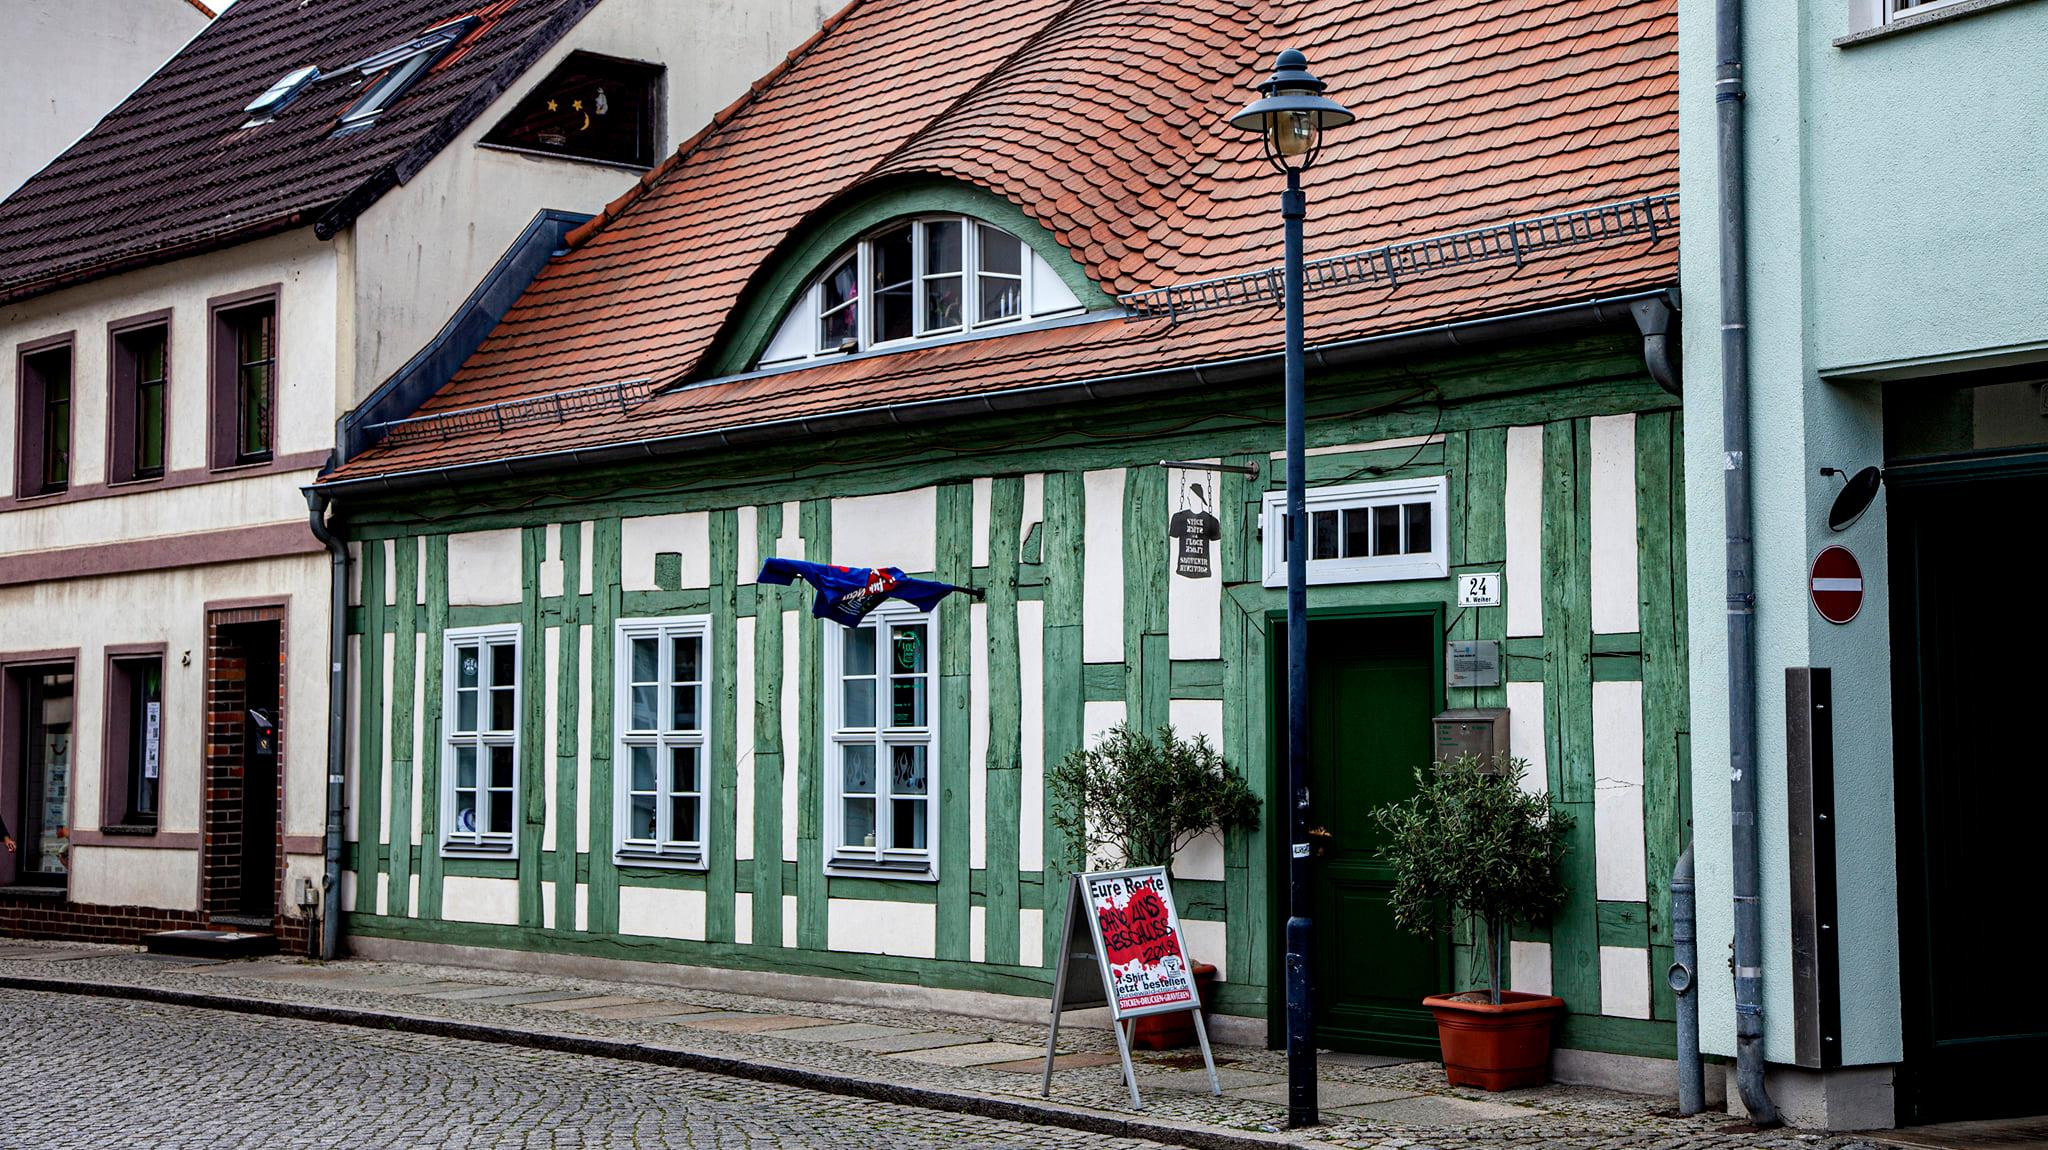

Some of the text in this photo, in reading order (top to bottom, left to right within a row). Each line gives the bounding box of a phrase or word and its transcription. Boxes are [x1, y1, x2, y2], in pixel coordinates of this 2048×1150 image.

[1470, 577, 1486, 595] 24
[1090, 876, 1165, 898] Eure Rente
[1115, 976, 1187, 997] jetzt bestellen
